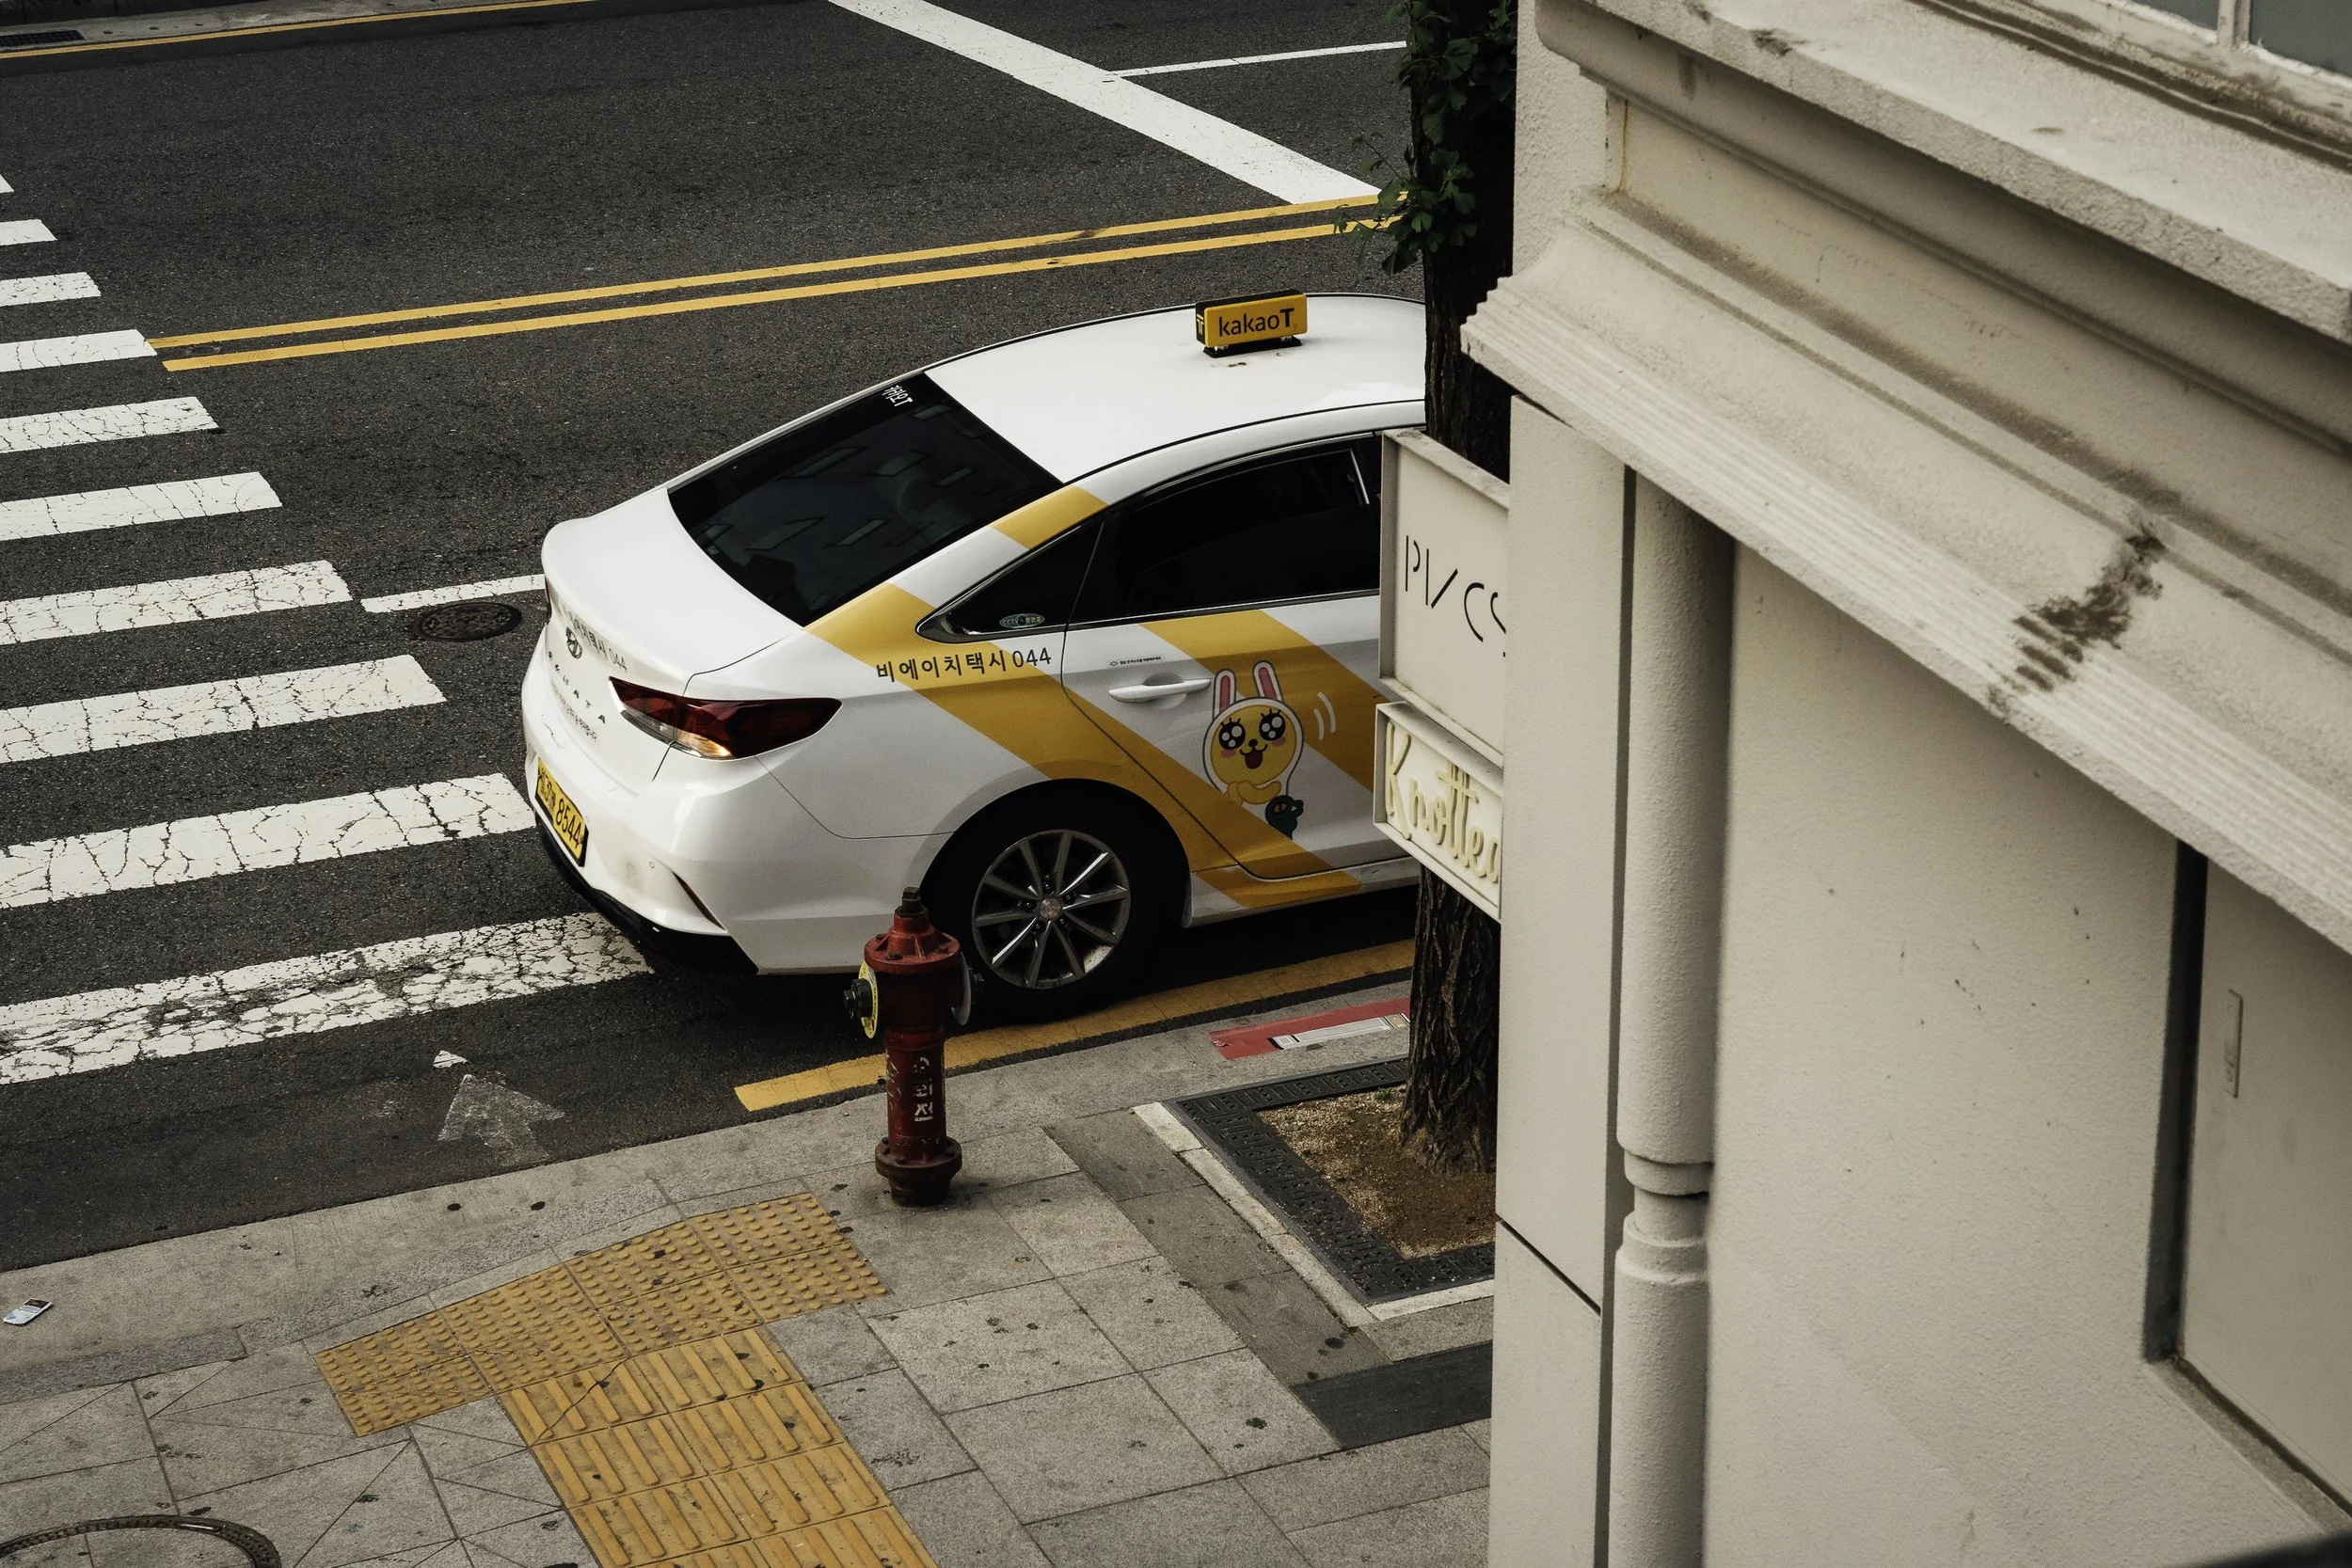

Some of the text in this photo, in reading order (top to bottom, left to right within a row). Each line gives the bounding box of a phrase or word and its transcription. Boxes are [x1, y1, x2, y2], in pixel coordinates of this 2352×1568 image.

[876, 647, 1052, 683] 비에이치택시 044
[555, 798, 581, 849] 8544
